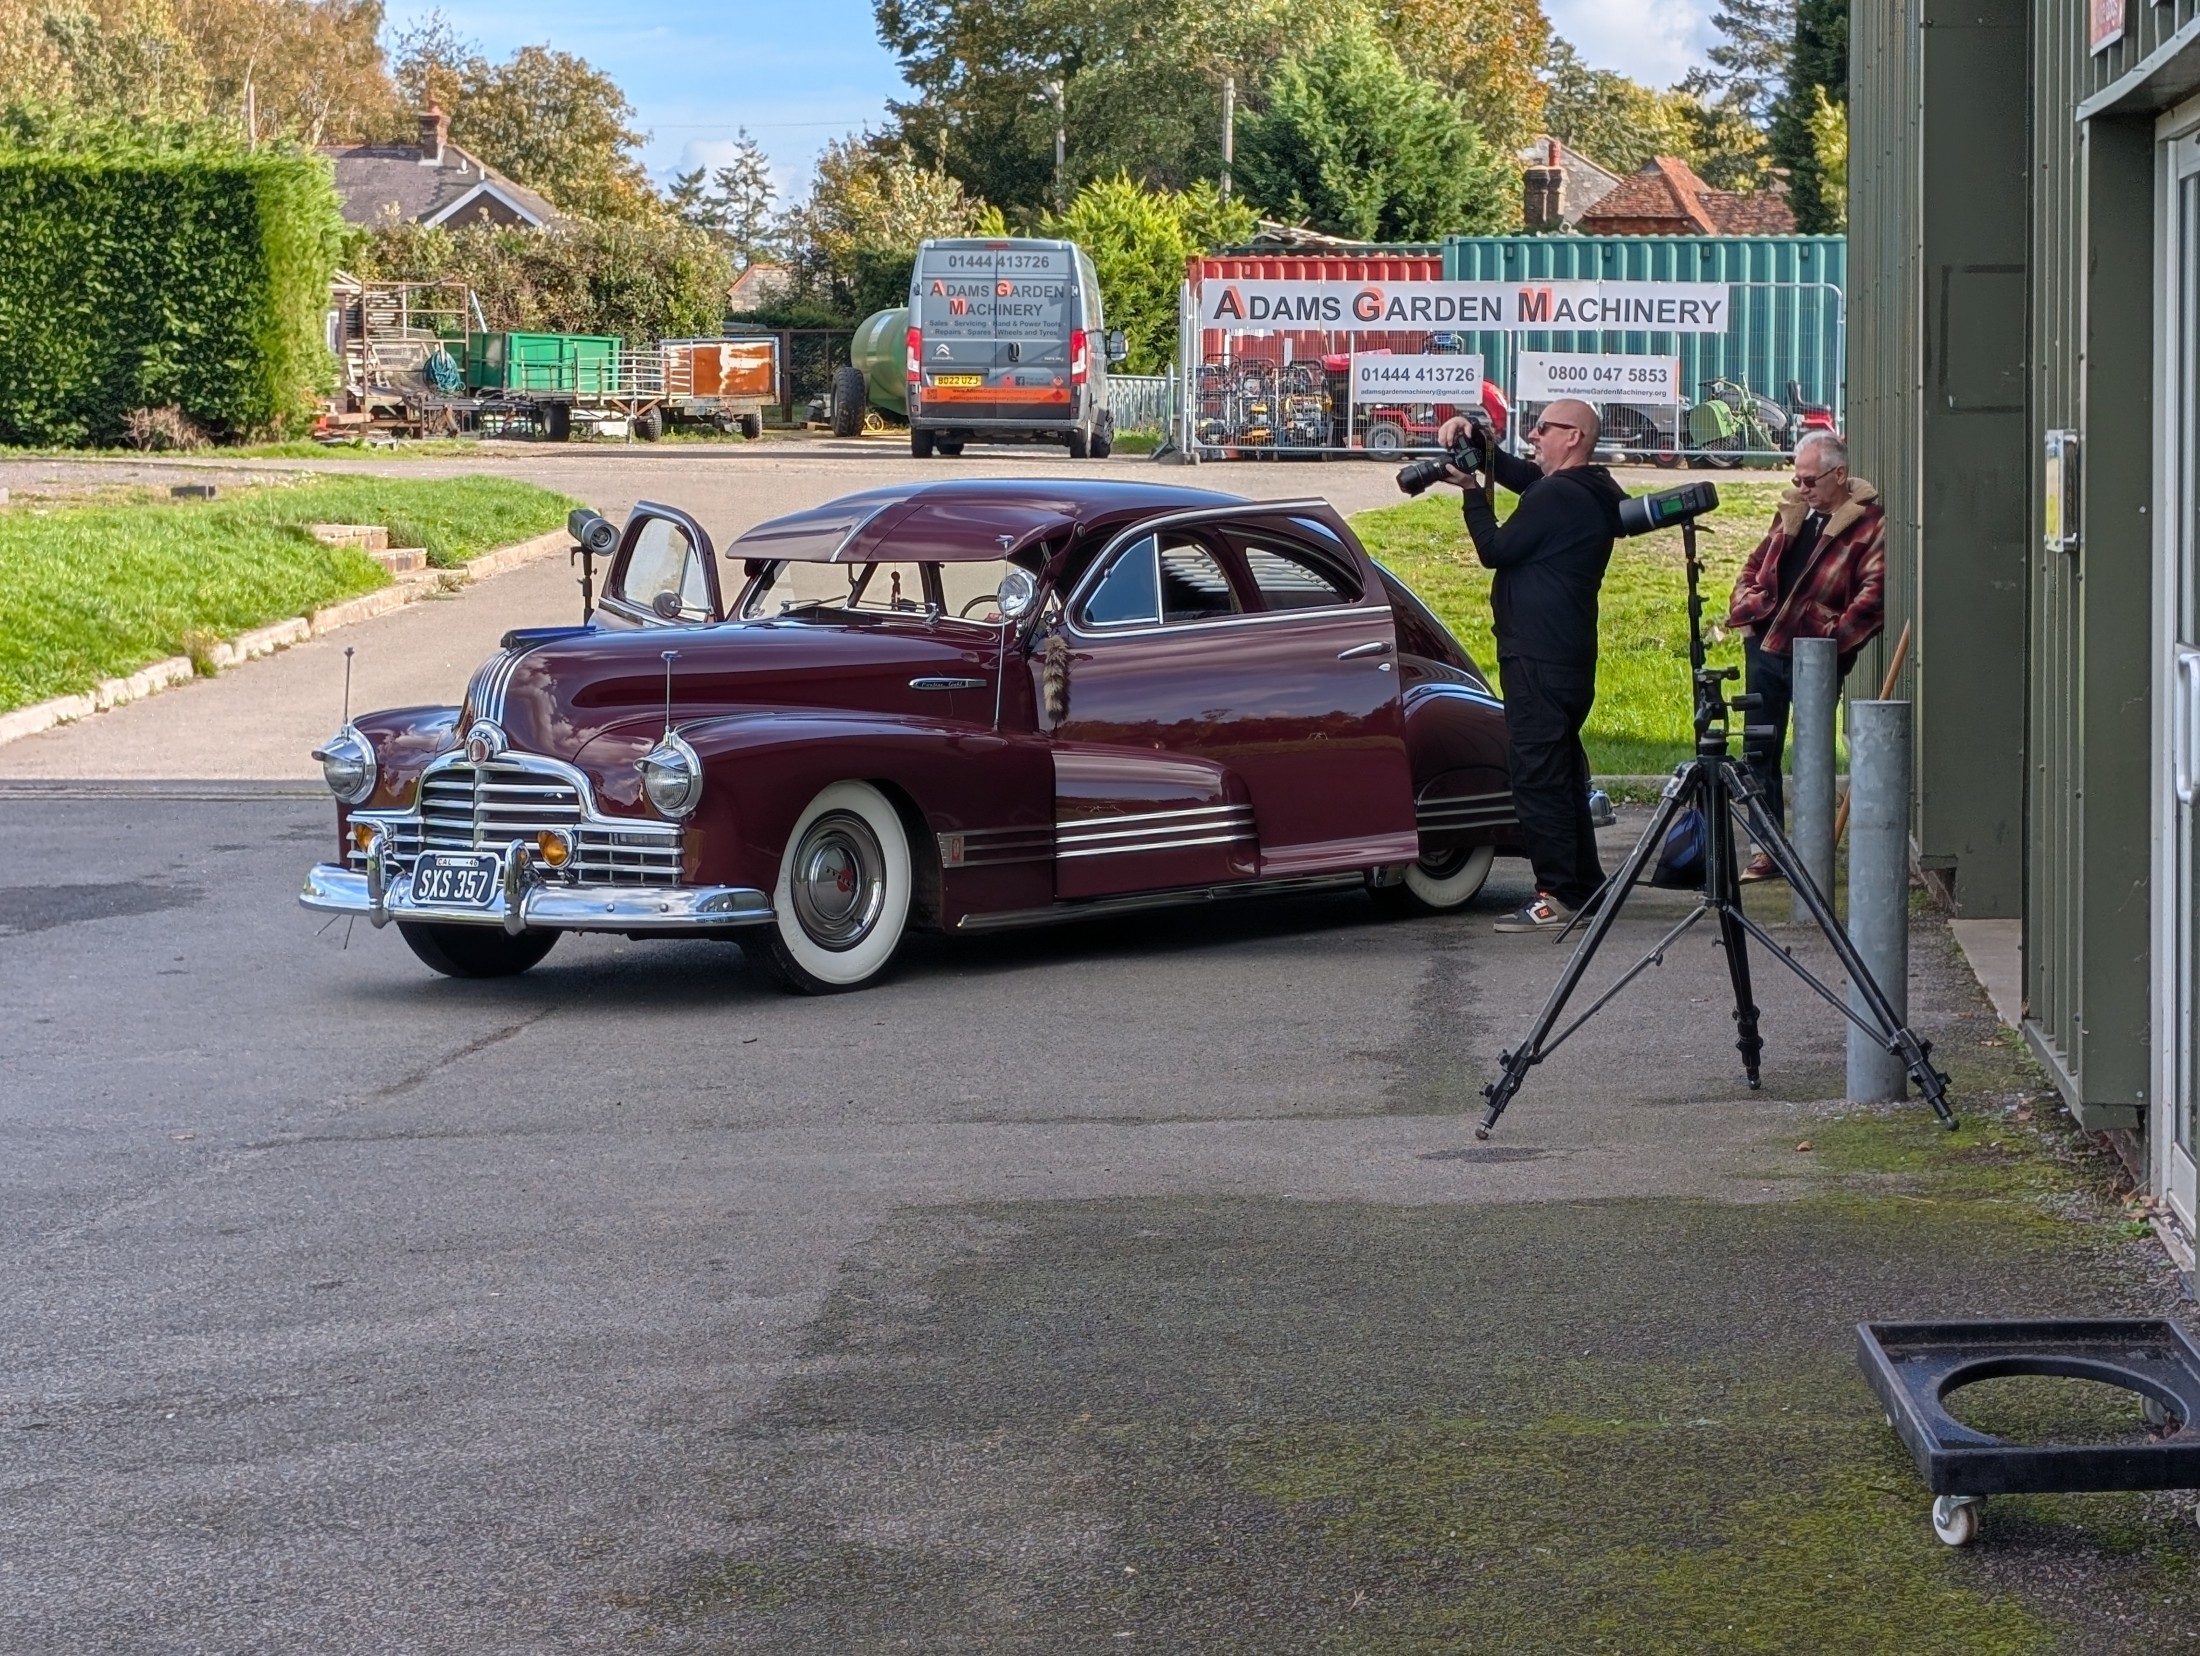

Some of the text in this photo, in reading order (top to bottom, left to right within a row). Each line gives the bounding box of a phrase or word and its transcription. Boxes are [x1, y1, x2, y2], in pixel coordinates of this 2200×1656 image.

[948, 255, 1050, 268] 01444 413726
[929, 280, 1064, 298] ADAMS GARDEN
[949, 298, 1043, 316] MACHINERY
[1213, 286, 1722, 324] ADAMS GARDEN MACHINERY
[954, 320, 987, 328] Servicing
[1361, 367, 1475, 381] 01444 413726
[1548, 366, 1667, 382] 0800 047 5853
[1360, 388, 1475, 396] adamsgardenmachinery@gmail.com
[1547, 387, 1667, 397] www.AdamsGardenMachinery.org
[437, 858, 452, 866] CAL
[418, 869, 488, 899] SXS 357
